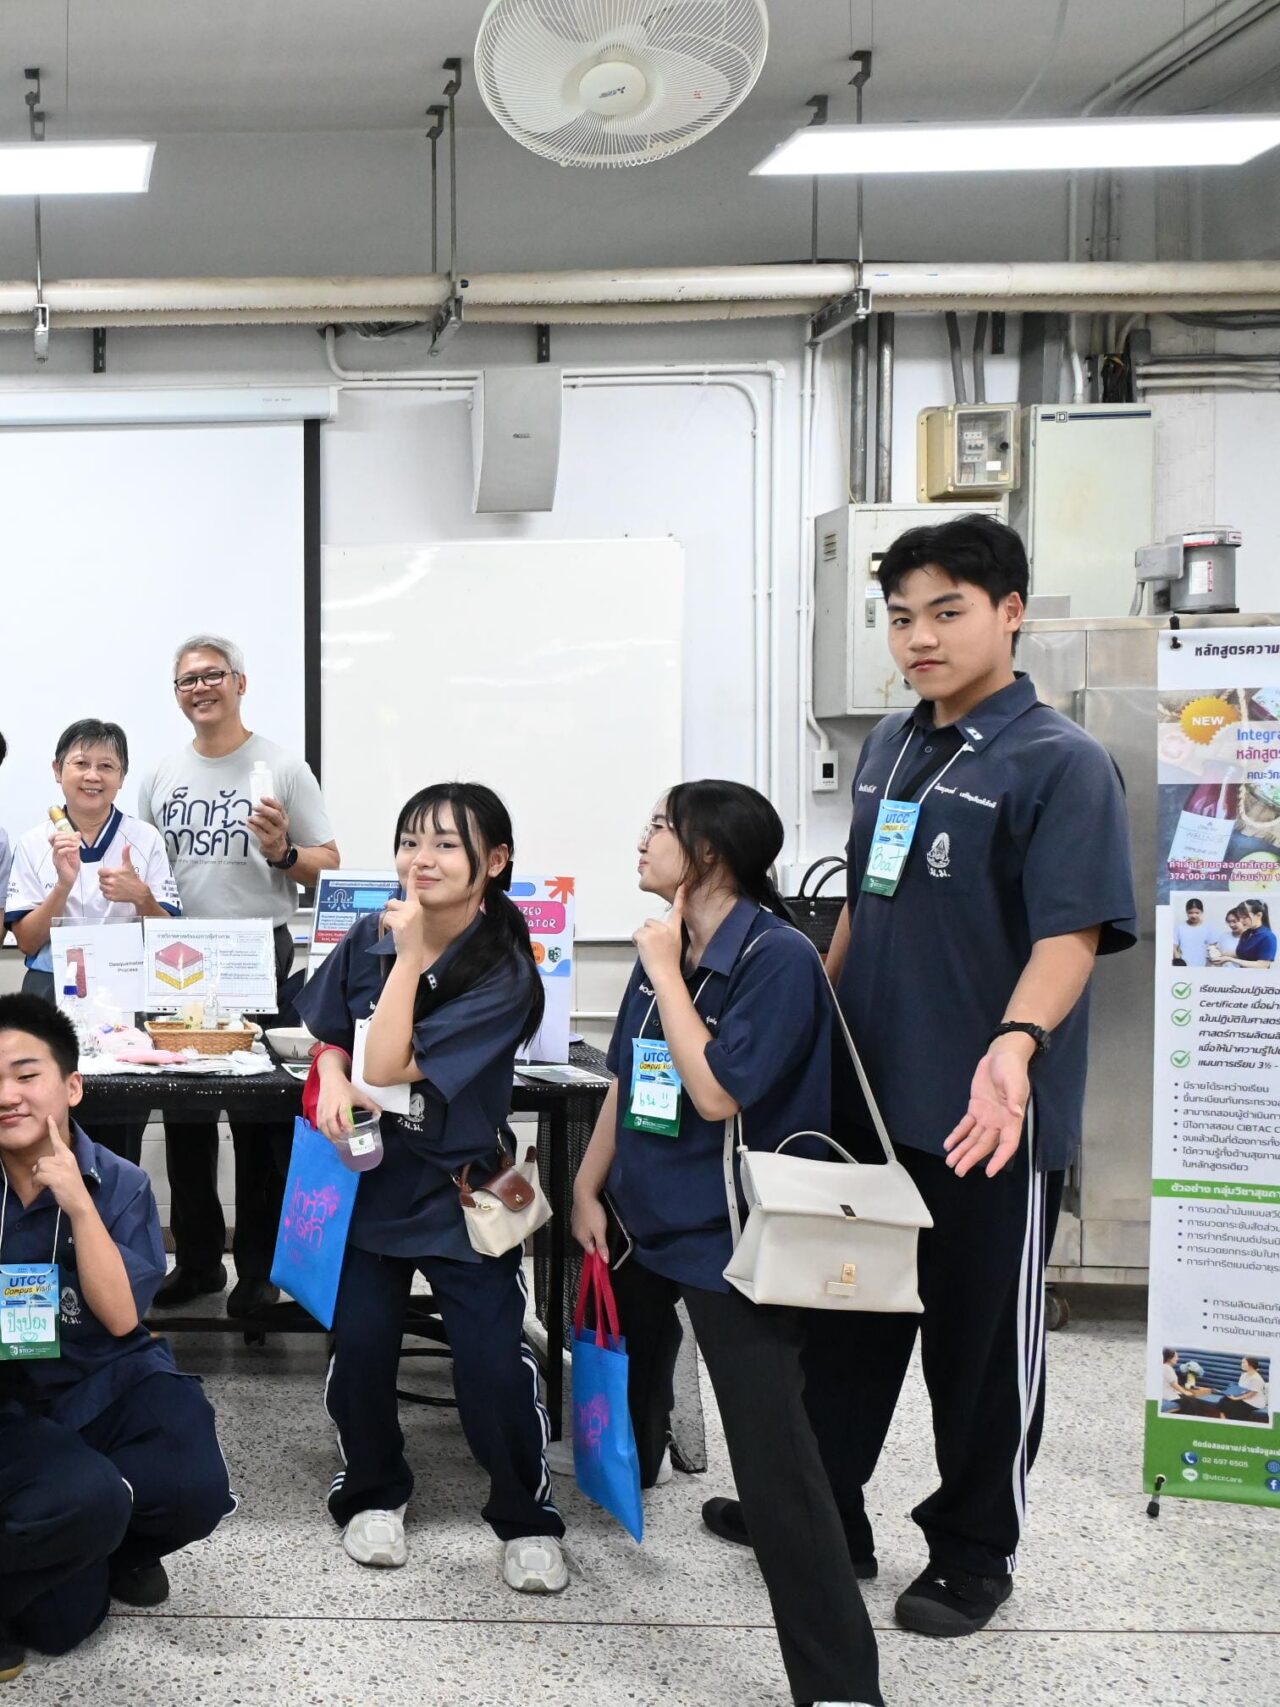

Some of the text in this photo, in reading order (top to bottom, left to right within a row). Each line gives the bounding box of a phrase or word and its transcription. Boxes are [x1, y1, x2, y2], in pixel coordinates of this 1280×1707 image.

[1192, 716, 1224, 726] NEW
[1236, 747, 1280, 763] หลักสูต
[162, 786, 253, 828] เด็กหัว
[885, 813, 910, 823] UTCC
[164, 820, 250, 857] การค้า
[526, 918, 557, 929] ATOR
[1199, 998, 1280, 1010] Certificate เมื่อผ่า
[10, 1275, 47, 1287] UTCC
[4, 1287, 33, 1296] Campus
